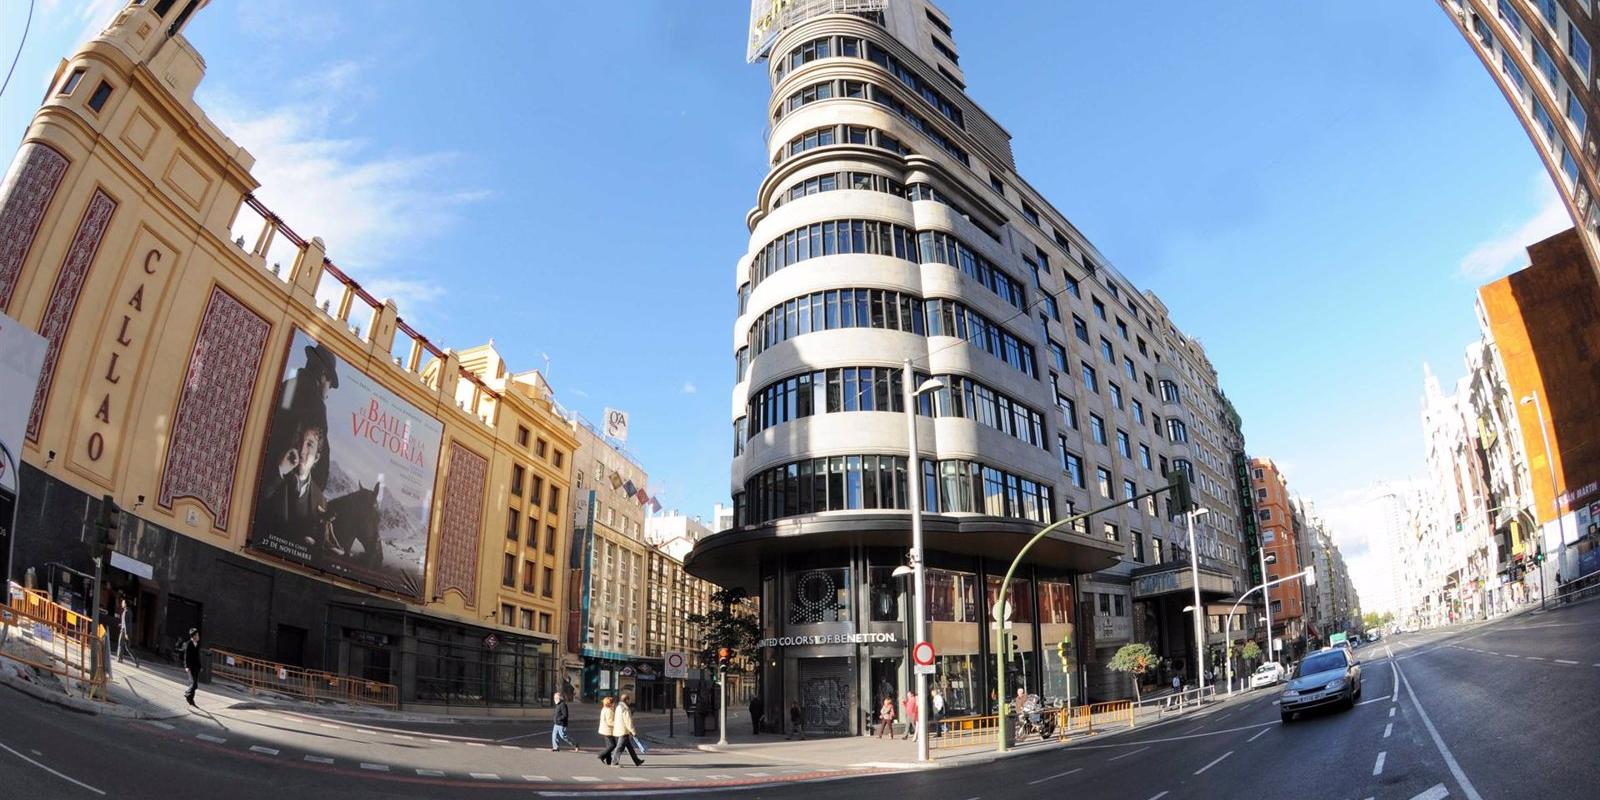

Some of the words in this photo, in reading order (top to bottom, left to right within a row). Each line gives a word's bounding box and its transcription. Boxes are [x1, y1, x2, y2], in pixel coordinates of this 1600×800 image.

[88, 249, 161, 461] CALLAO
[352, 411, 423, 467] VICTORIA
[367, 399, 409, 440] BAILE
[1237, 455, 1249, 507] HOTEL
[270, 541, 278, 549] DE
[280, 544, 311, 560] NOVIEMBRE
[779, 636, 812, 645] COLORS
[816, 636, 832, 644] OF
